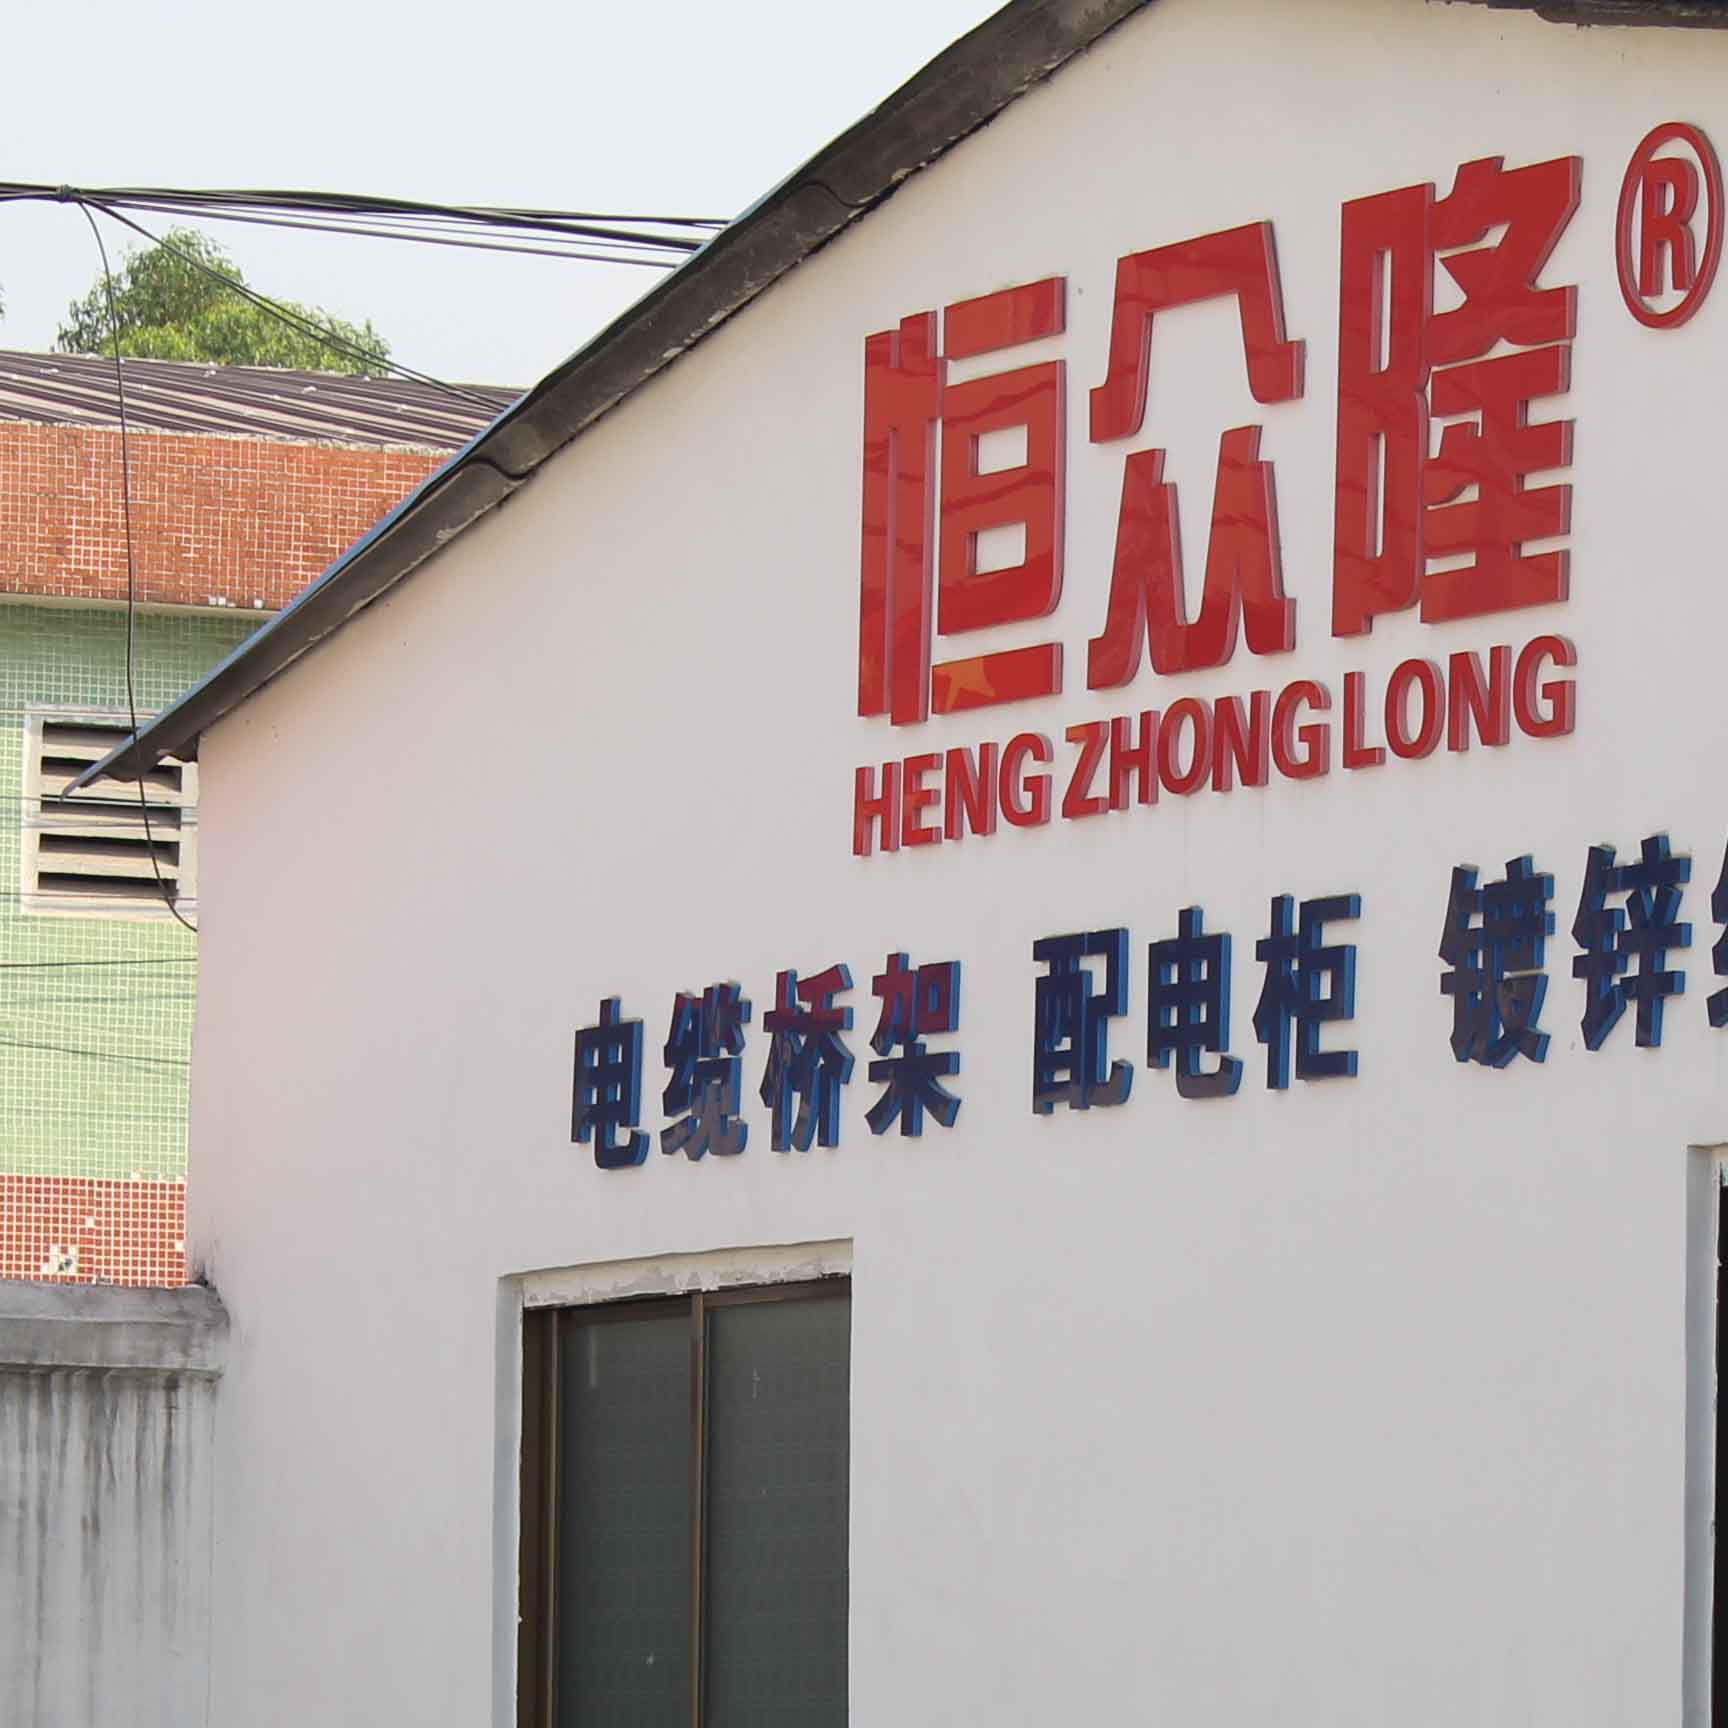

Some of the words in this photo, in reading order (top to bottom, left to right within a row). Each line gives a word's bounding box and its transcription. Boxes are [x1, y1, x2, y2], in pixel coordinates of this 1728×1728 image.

[857, 155, 1581, 727] 恒众隆
[853, 732, 1053, 857] HENG
[1062, 680, 1331, 819] ZHONG
[1342, 635, 1577, 770] LONG
[570, 951, 962, 1169] 电缆桥架
[1032, 891, 1362, 1115] 配电柜
